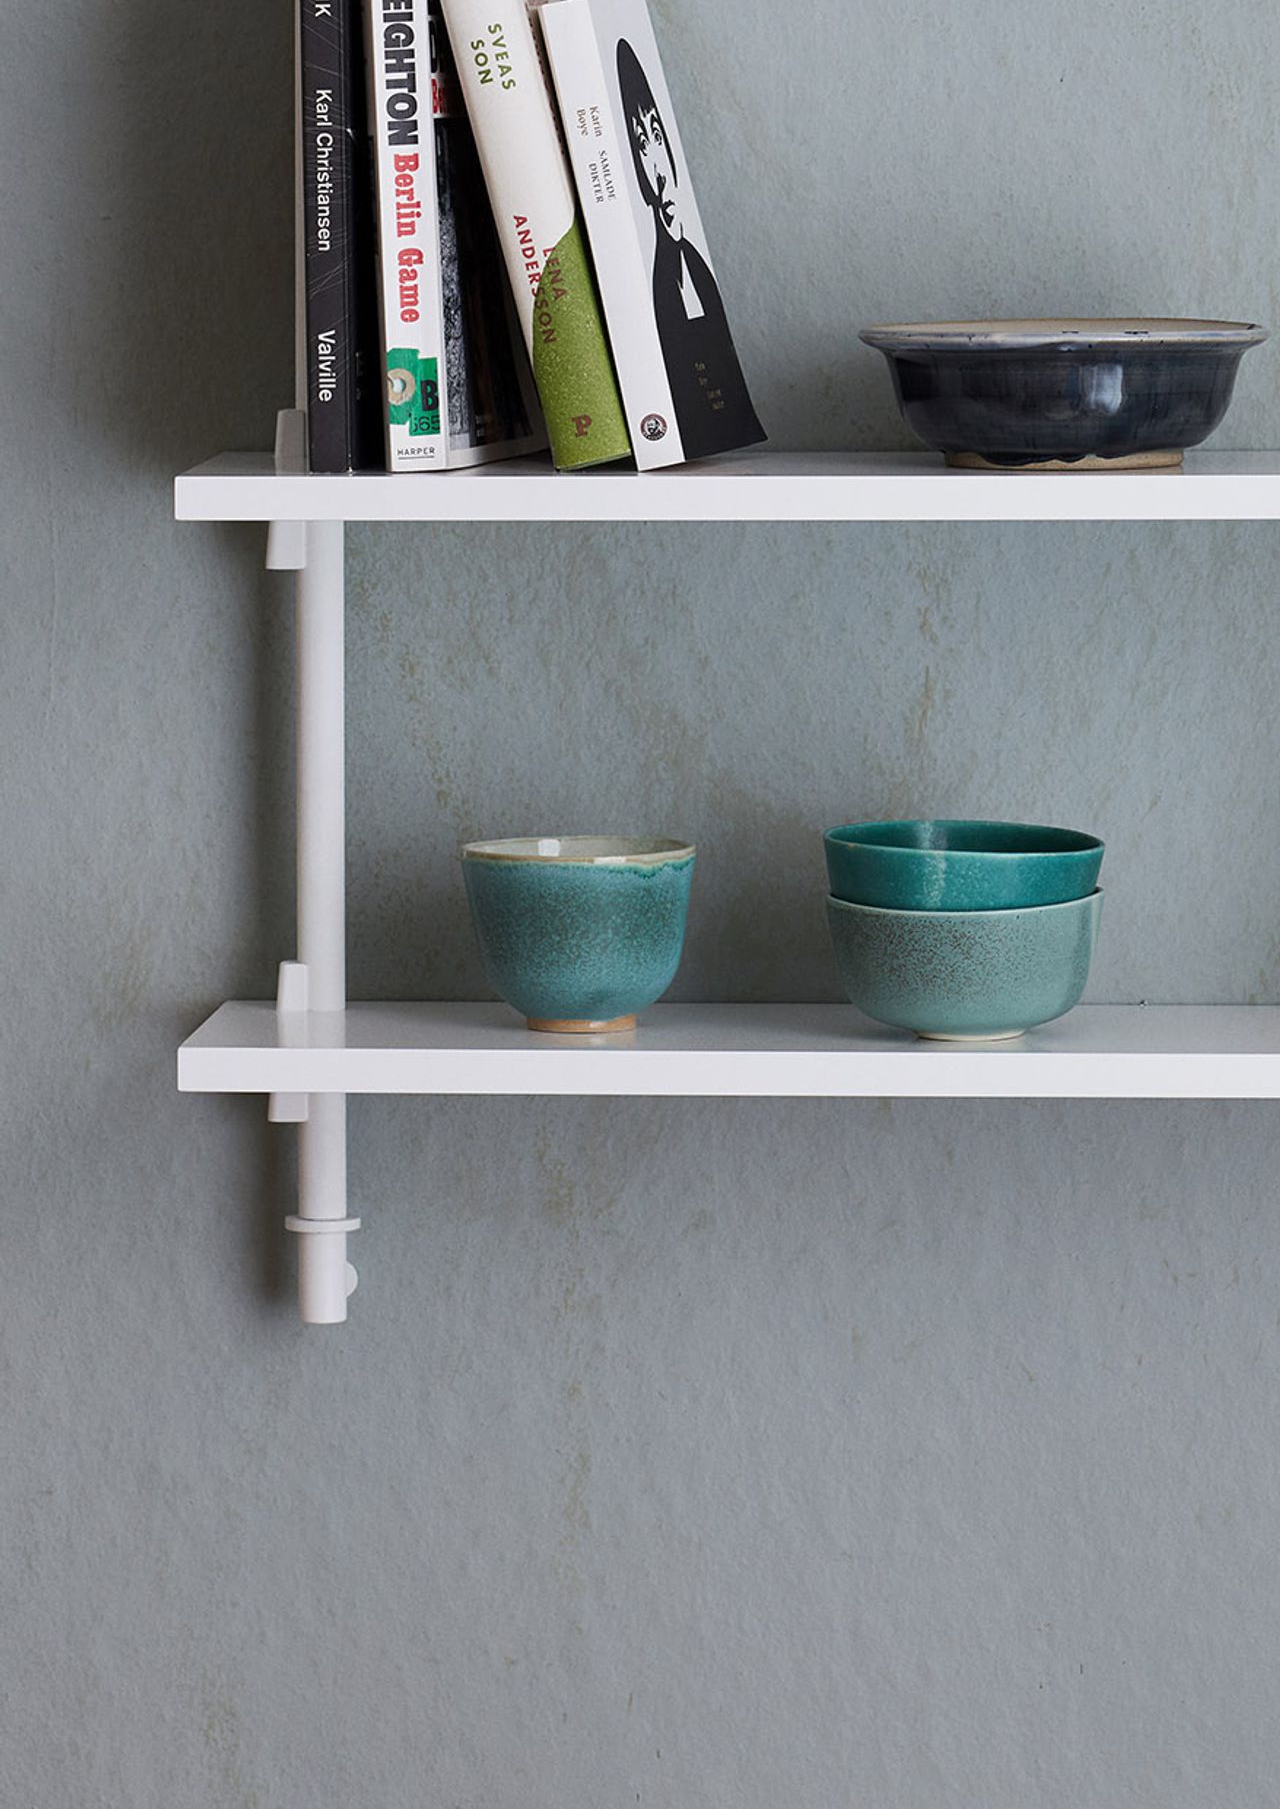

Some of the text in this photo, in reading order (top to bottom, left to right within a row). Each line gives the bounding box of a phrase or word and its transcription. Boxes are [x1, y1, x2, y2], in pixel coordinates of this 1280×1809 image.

[471, 39, 493, 85] SON
[488, 23, 516, 90] SVEAS
[316, 90, 332, 126] Karl
[577, 108, 588, 137] Boye
[589, 106, 602, 138] Karin
[317, 133, 333, 251] Christiansen
[394, 153, 421, 238] Berlin
[588, 162, 604, 204] DIKTER
[599, 149, 616, 200] SAMLADE
[398, 247, 423, 323] Game
[513, 215, 557, 344] ANDERSSON
[543, 247, 567, 302] LENA
[319, 330, 335, 403] Valville
[421, 380, 438, 411] B
[571, 414, 593, 438] P
[397, 447, 435, 456] HARPER
